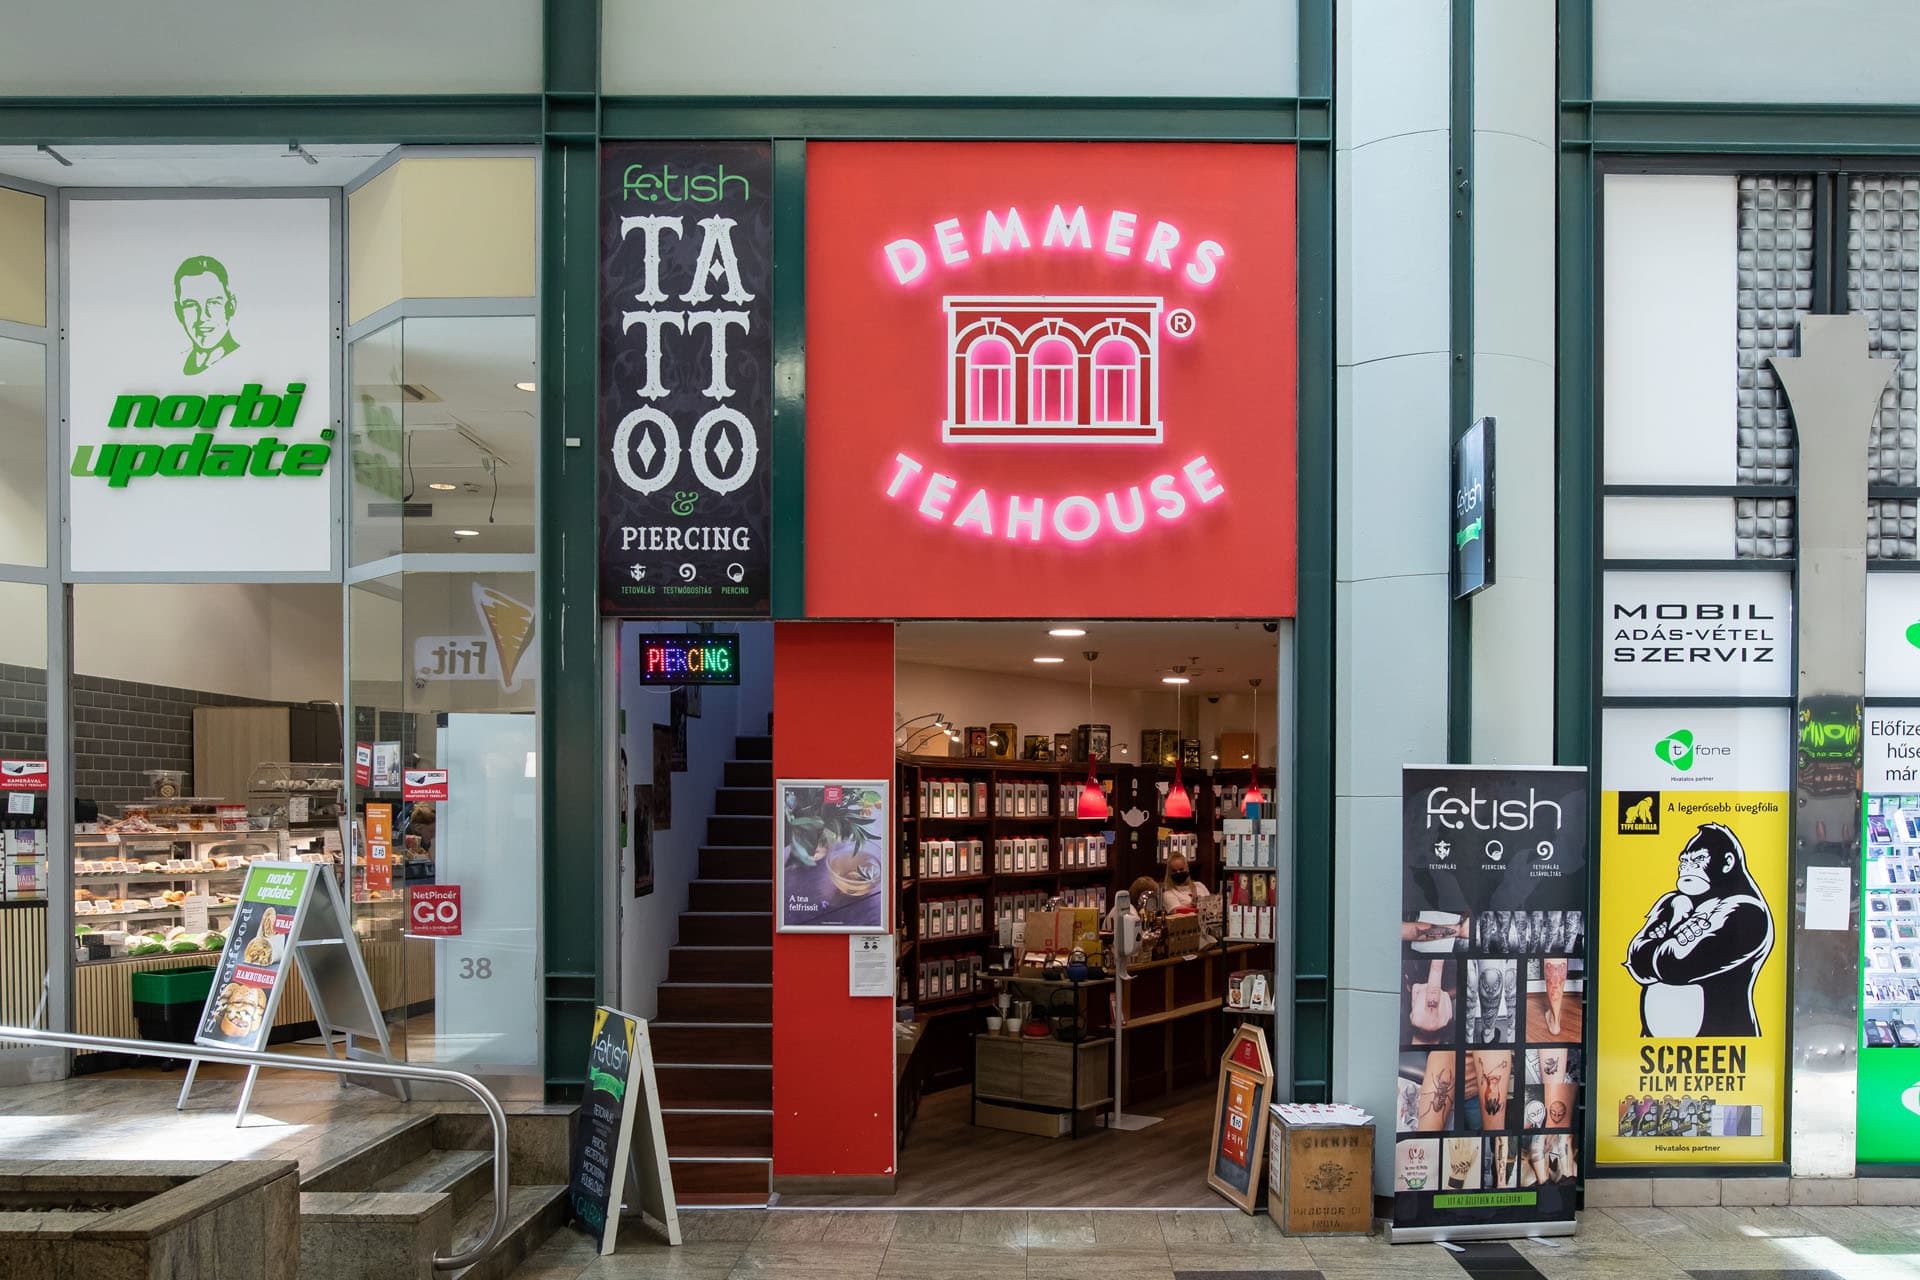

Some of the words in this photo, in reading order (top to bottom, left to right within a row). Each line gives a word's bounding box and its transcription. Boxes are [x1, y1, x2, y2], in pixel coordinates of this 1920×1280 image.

[623, 164, 749, 203] fetish
[884, 204, 1225, 285] DEMMERS
[108, 383, 306, 428] norbi
[671, 491, 699, 516] &
[886, 452, 1225, 541] TEAHOUSE
[1456, 477, 1482, 517] fetish
[621, 526, 750, 551] PIERCING
[621, 584, 656, 595] TETOVÁLÁS
[663, 584, 712, 595] TESTMÓDOSÍTÁS
[721, 586, 749, 595] PIERCING
[1614, 604, 1774, 620] MOBIL
[1615, 624, 1774, 641] ADÁS-VÉTEL
[648, 649, 729, 671] PIERCING
[1614, 647, 1774, 662] SZERVIZ
[1695, 744, 1731, 756] fone
[1886, 766, 1918, 781] már
[1427, 787, 1562, 830] fetish
[1667, 804, 1675, 813] A
[1678, 802, 1731, 814] legerősebb
[1735, 802, 1778, 814] üvegfólia
[1620, 823, 1634, 831] TYPE
[1634, 823, 1658, 831] GORILLA
[266, 872, 295, 885] norbi
[412, 890, 457, 899] NetPincér
[789, 895, 796, 903] A
[797, 895, 809, 903] tea
[413, 901, 458, 923] GO
[459, 957, 492, 979] 38
[1640, 1045, 1746, 1074] SCREEN
[1639, 1075, 1677, 1092] FILM
[1684, 1075, 1746, 1092] EXPERT
[1655, 1144, 1690, 1152] Hivatalos
[1692, 1145, 1721, 1153] partner
